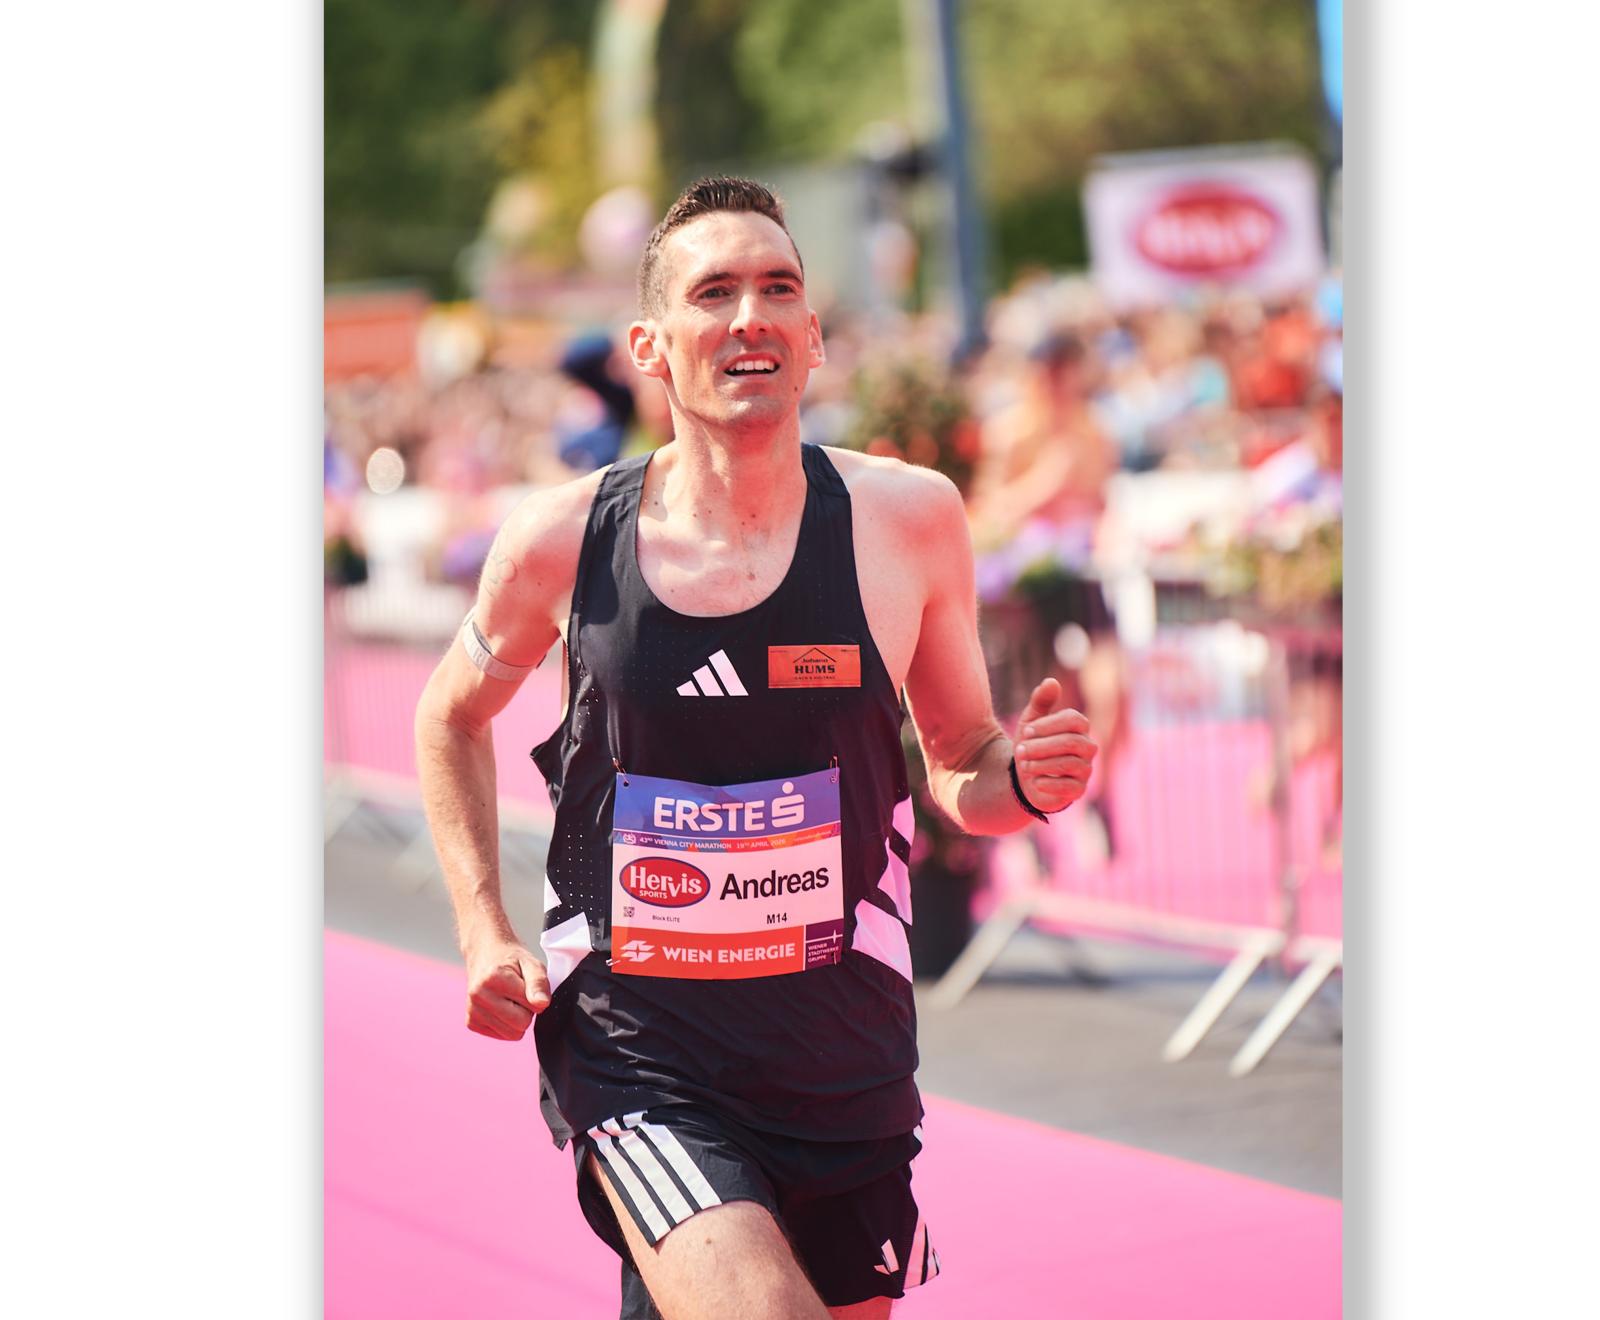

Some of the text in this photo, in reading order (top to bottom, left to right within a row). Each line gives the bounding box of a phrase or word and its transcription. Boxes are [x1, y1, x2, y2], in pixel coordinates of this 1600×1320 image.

[795, 664, 835, 674] HUMS
[653, 796, 765, 832] ERSTE
[654, 838, 678, 848] VIENNA
[679, 841, 694, 849] CITY
[629, 865, 703, 898] Hervis
[719, 867, 830, 900] Andreas
[639, 889, 668, 899] SPORTS
[766, 912, 788, 924] M14
[808, 942, 828, 951] WIENER
[662, 942, 796, 963] WIEN ENERGIE
[807, 954, 827, 963] GRUPPE
